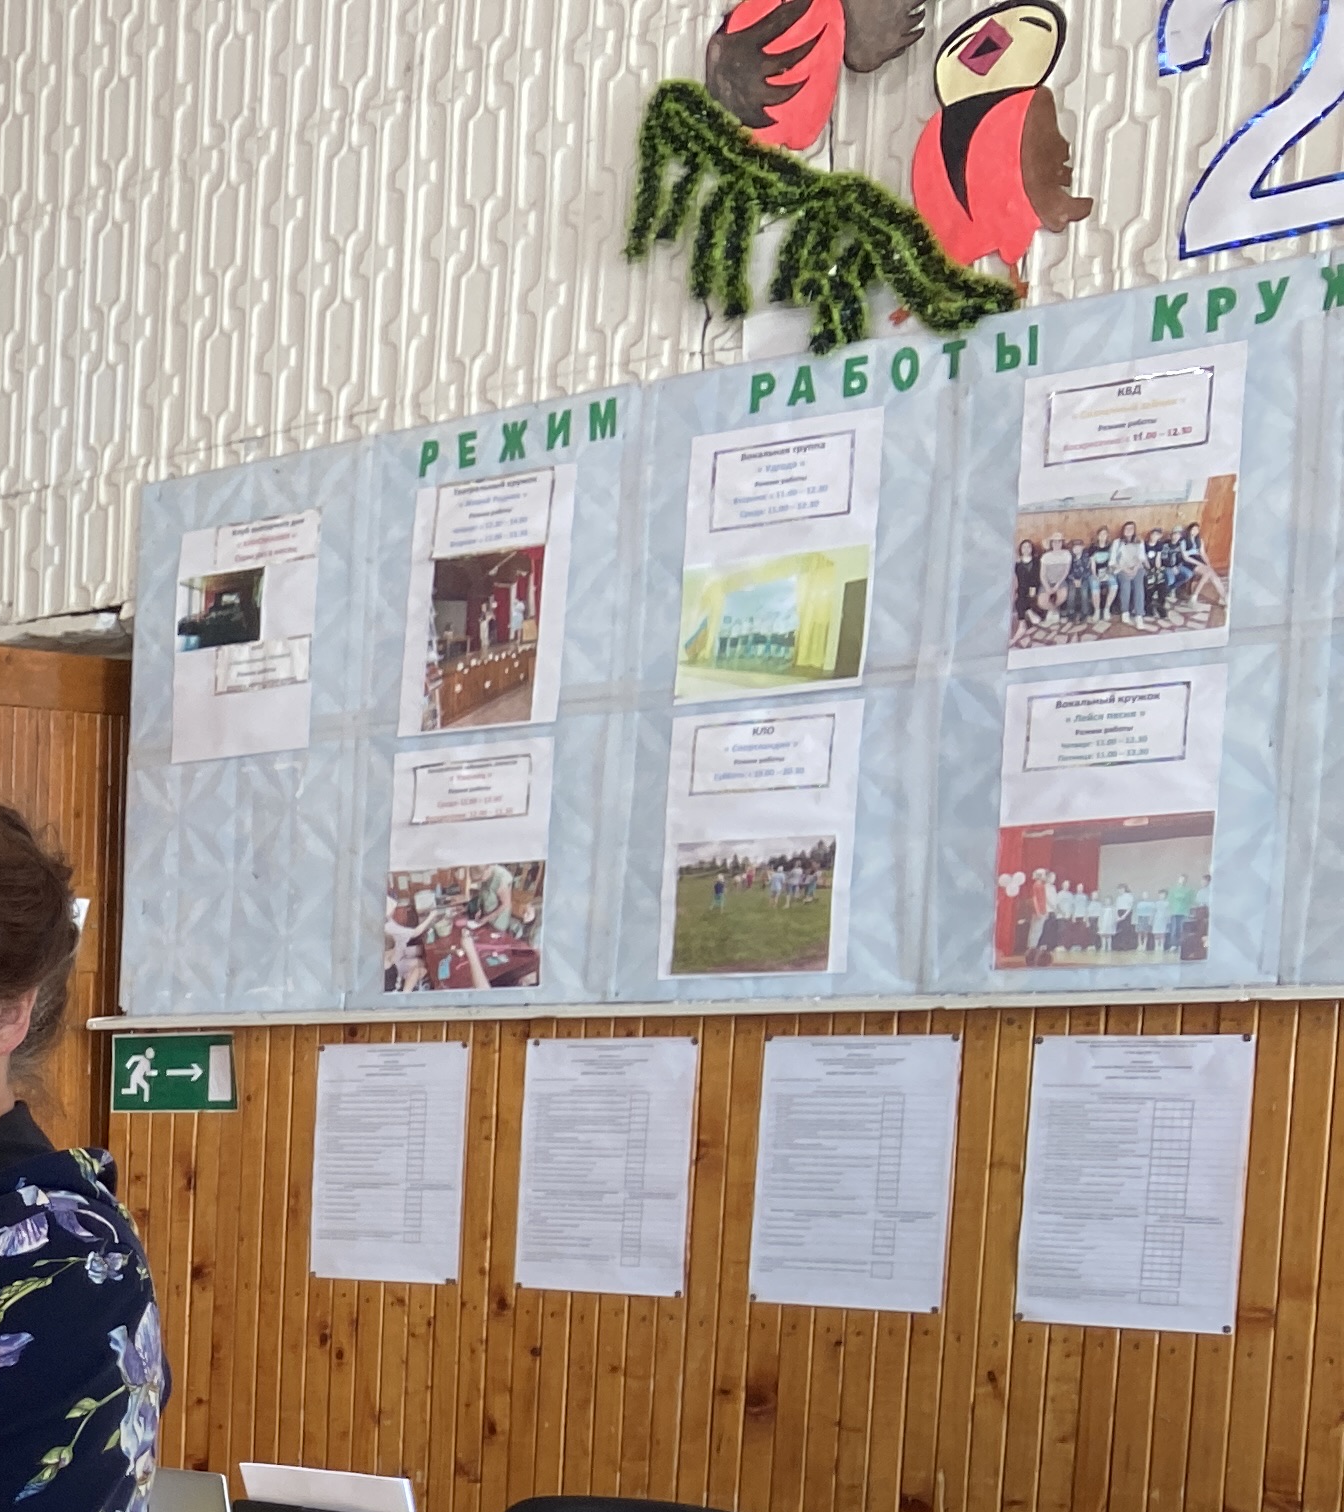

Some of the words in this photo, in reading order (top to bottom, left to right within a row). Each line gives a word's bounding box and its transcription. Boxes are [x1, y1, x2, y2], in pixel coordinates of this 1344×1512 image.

[419, 397, 617, 477] РЕЖИМ
[749, 325, 1039, 413] РАБОТЫ
[1055, 694, 1115, 709] Вокальный
[1118, 692, 1160, 704] кружок
